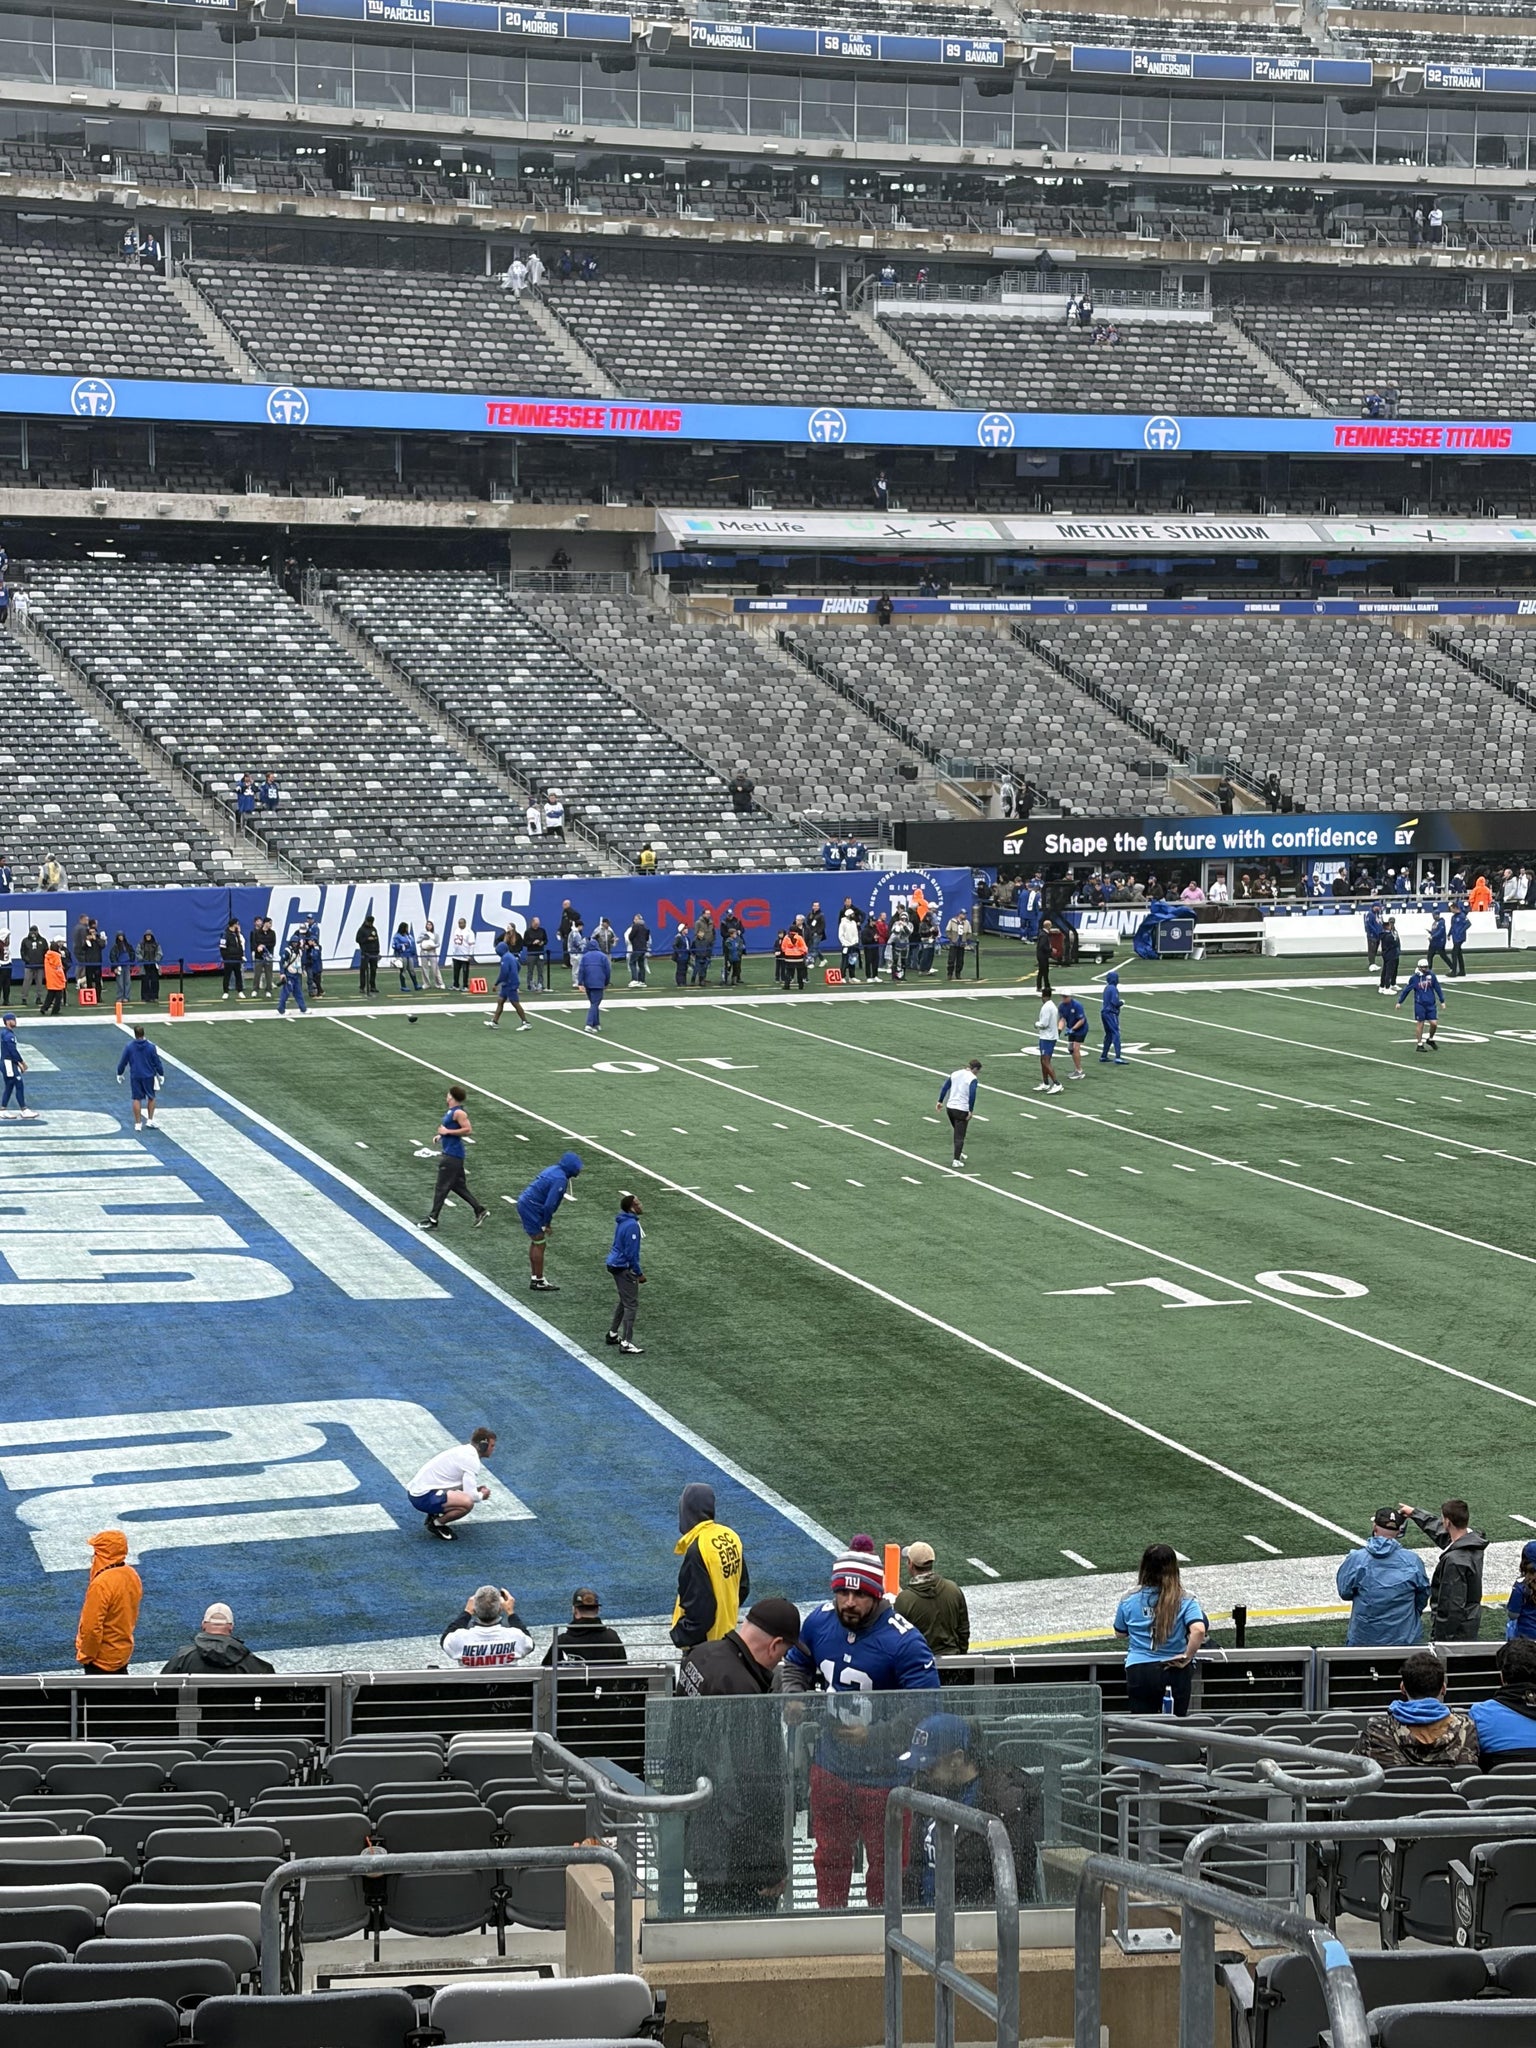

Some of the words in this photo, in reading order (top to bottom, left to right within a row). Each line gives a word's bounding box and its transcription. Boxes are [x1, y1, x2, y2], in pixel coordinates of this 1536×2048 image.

[384, 6, 430, 23] PARCELLS
[505, 12, 521, 26] 20
[522, 20, 558, 35] MORRIS
[692, 26, 707, 40] 70
[707, 33, 753, 49] MARSHALL
[825, 36, 839, 50] 58
[849, 34, 864, 43] CARL
[972, 41, 990, 50] MARK
[842, 42, 872, 56] BANKS
[946, 44, 960, 57] 89
[965, 50, 998, 63] BAVARO
[1135, 55, 1148, 68] 24
[1147, 61, 1191, 76] ANDERSON
[1255, 61, 1270, 75] 27
[1268, 67, 1310, 81] HAMPTON
[1428, 69, 1441, 82] 92
[1442, 75, 1481, 88] STRAHAN
[486, 402, 606, 429] TENNESSEE
[609, 406, 682, 432] TITANS
[1334, 425, 1443, 448] TENNESSEE
[1444, 427, 1513, 448] TITANS
[718, 521, 806, 533] MetLife
[1055, 524, 1160, 539] METLIFE
[1163, 525, 1270, 539] STADIUM
[821, 598, 869, 613] GIANTS
[950, 603, 964, 611] NEW
[965, 603, 980, 611] YORK
[1009, 603, 1031, 611] GIANTS
[1358, 604, 1372, 612] NEW
[1373, 604, 1388, 612] YORK
[1417, 604, 1439, 612] GIANTS
[1003, 840, 1023, 854] EY
[1045, 833, 1108, 857] Shape
[1113, 832, 1148, 851] the
[1153, 831, 1216, 851] future
[1222, 829, 1265, 849] with
[1271, 827, 1378, 848] confidence
[1395, 830, 1415, 845] EY
[869, 887, 879, 907] NEW
[877, 872, 895, 887] YORK
[930, 878, 944, 906] GIANTS
[888, 883, 926, 891] SINCE
[656, 898, 772, 929] NYG
[268, 879, 532, 970] GIANTS
[1080, 911, 1150, 936] GIANT
[828, 969, 842, 982] 20
[473, 979, 487, 992] 10
[83, 990, 94, 1002] G
[1106, 1269, 1370, 1309] 10
[711, 1532, 734, 1550] CSC
[718, 1544, 740, 1566] EVENT
[844, 1575, 861, 1590] ny
[462, 1644, 488, 1657] NEW
[489, 1641, 517, 1656] YORK
[461, 1653, 516, 1667] GIANTS
[684, 1660, 705, 1688] GUEST
